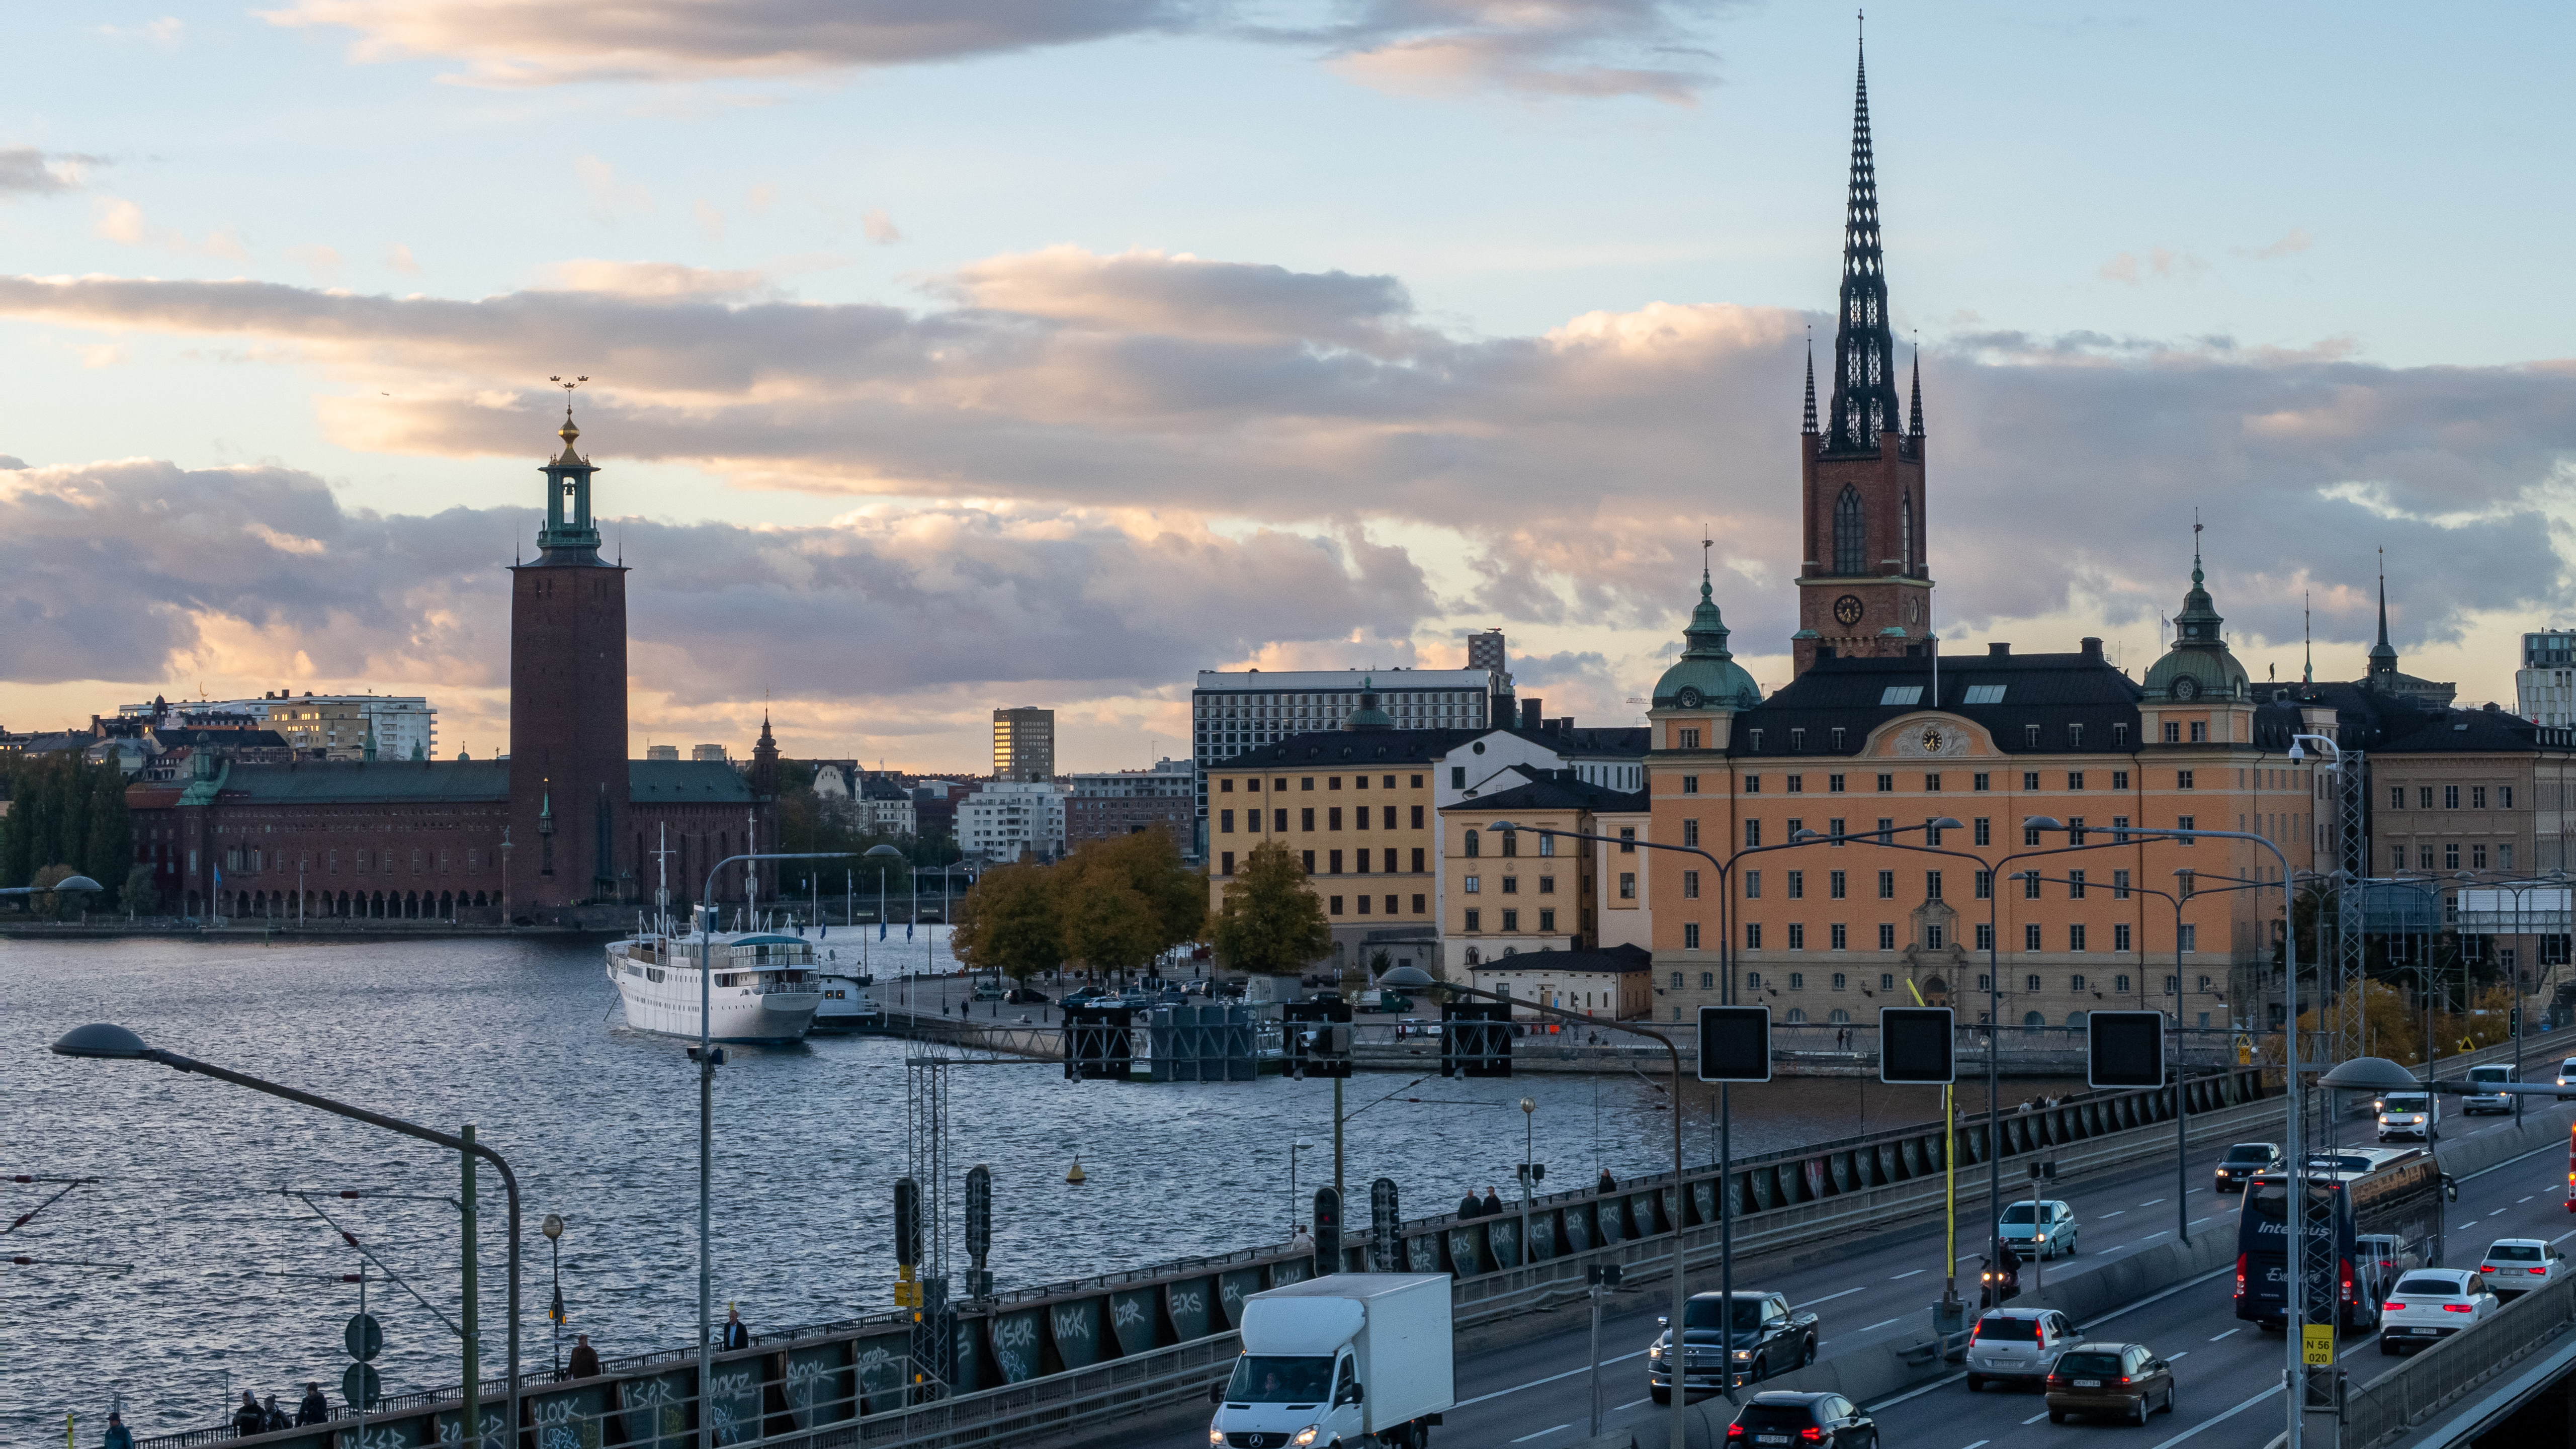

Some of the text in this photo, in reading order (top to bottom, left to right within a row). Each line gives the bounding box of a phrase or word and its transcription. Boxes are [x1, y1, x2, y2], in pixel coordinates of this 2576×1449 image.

[2306, 1340, 2330, 1349] N 56
[2309, 1353, 2327, 1362] 020
